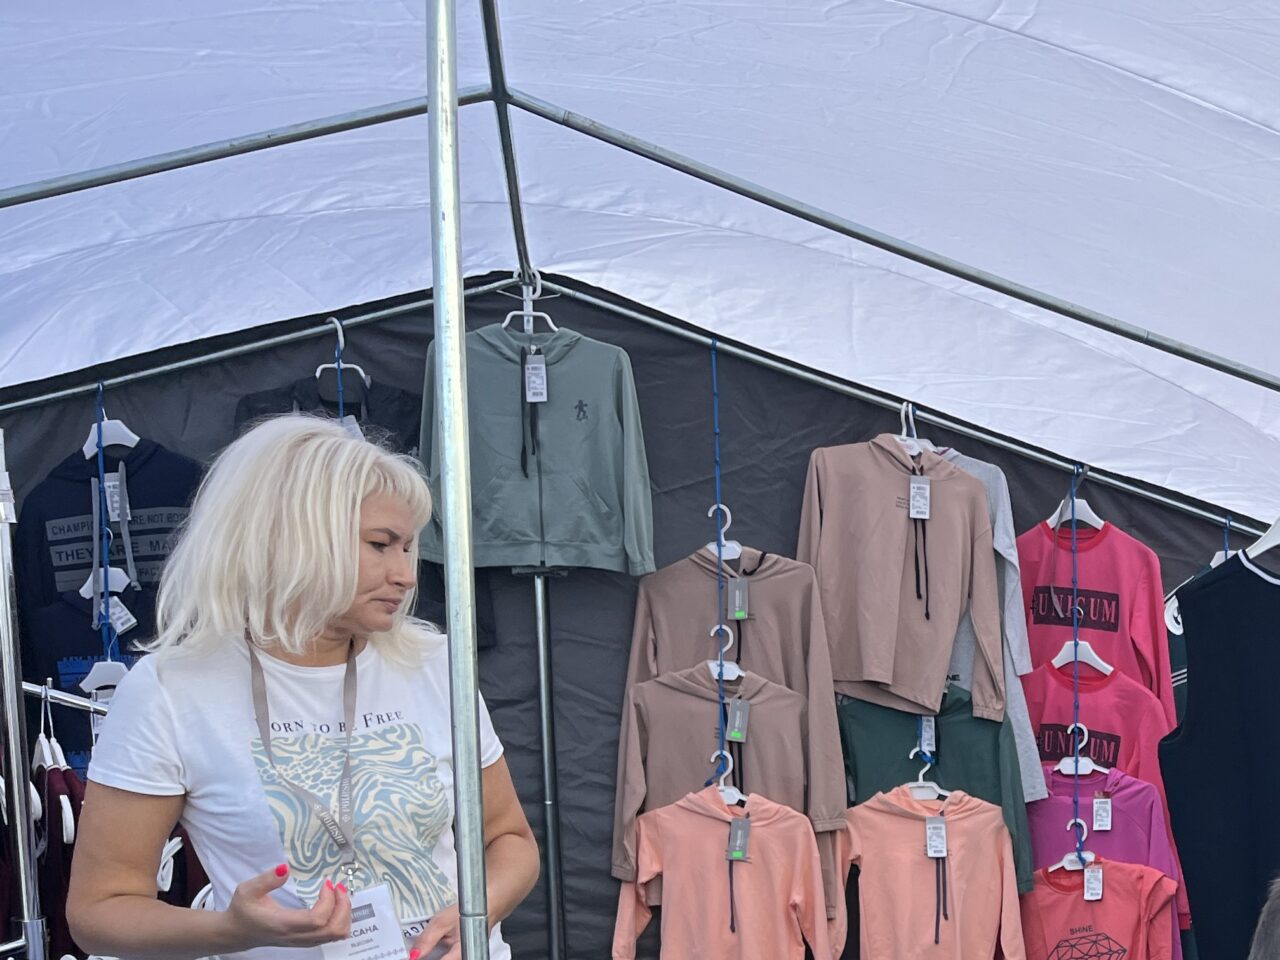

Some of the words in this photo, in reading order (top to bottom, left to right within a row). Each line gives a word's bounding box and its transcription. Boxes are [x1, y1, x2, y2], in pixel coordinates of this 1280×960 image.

[51, 520, 94, 536] CHAMPI
[147, 513, 164, 523] NOT
[271, 720, 304, 733] ORN
[350, 924, 379, 939] САНА
[1070, 925, 1094, 936] SHINE
